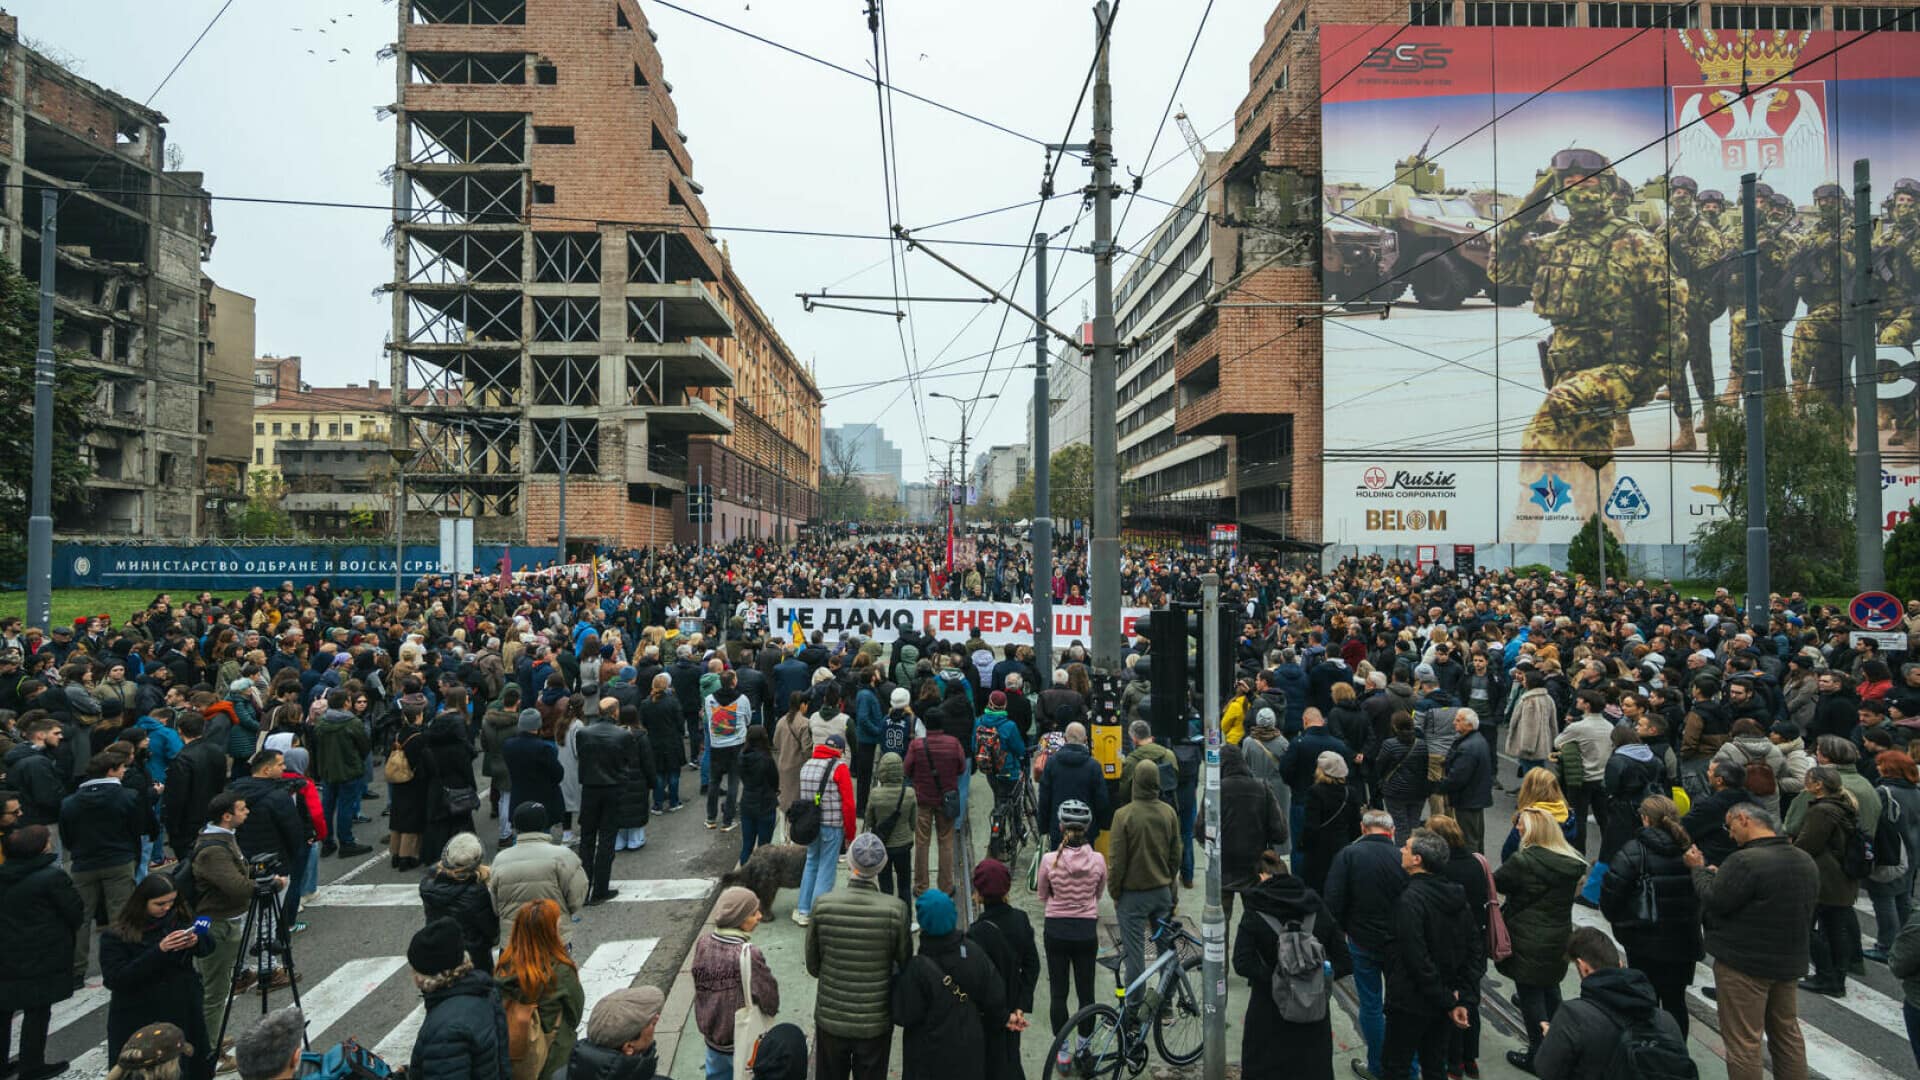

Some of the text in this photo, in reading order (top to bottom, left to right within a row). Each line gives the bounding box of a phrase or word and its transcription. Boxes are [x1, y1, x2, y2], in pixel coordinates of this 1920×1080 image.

[1366, 509, 1447, 531] BELOM
[116, 561, 239, 571] МИНИСТАРСТВО
[244, 561, 318, 572] ОДБРАНЕ
[325, 561, 334, 571] И
[339, 561, 398, 572] ВОЈСКА
[777, 607, 814, 629] НЕ
[823, 608, 914, 633] ДАМО
